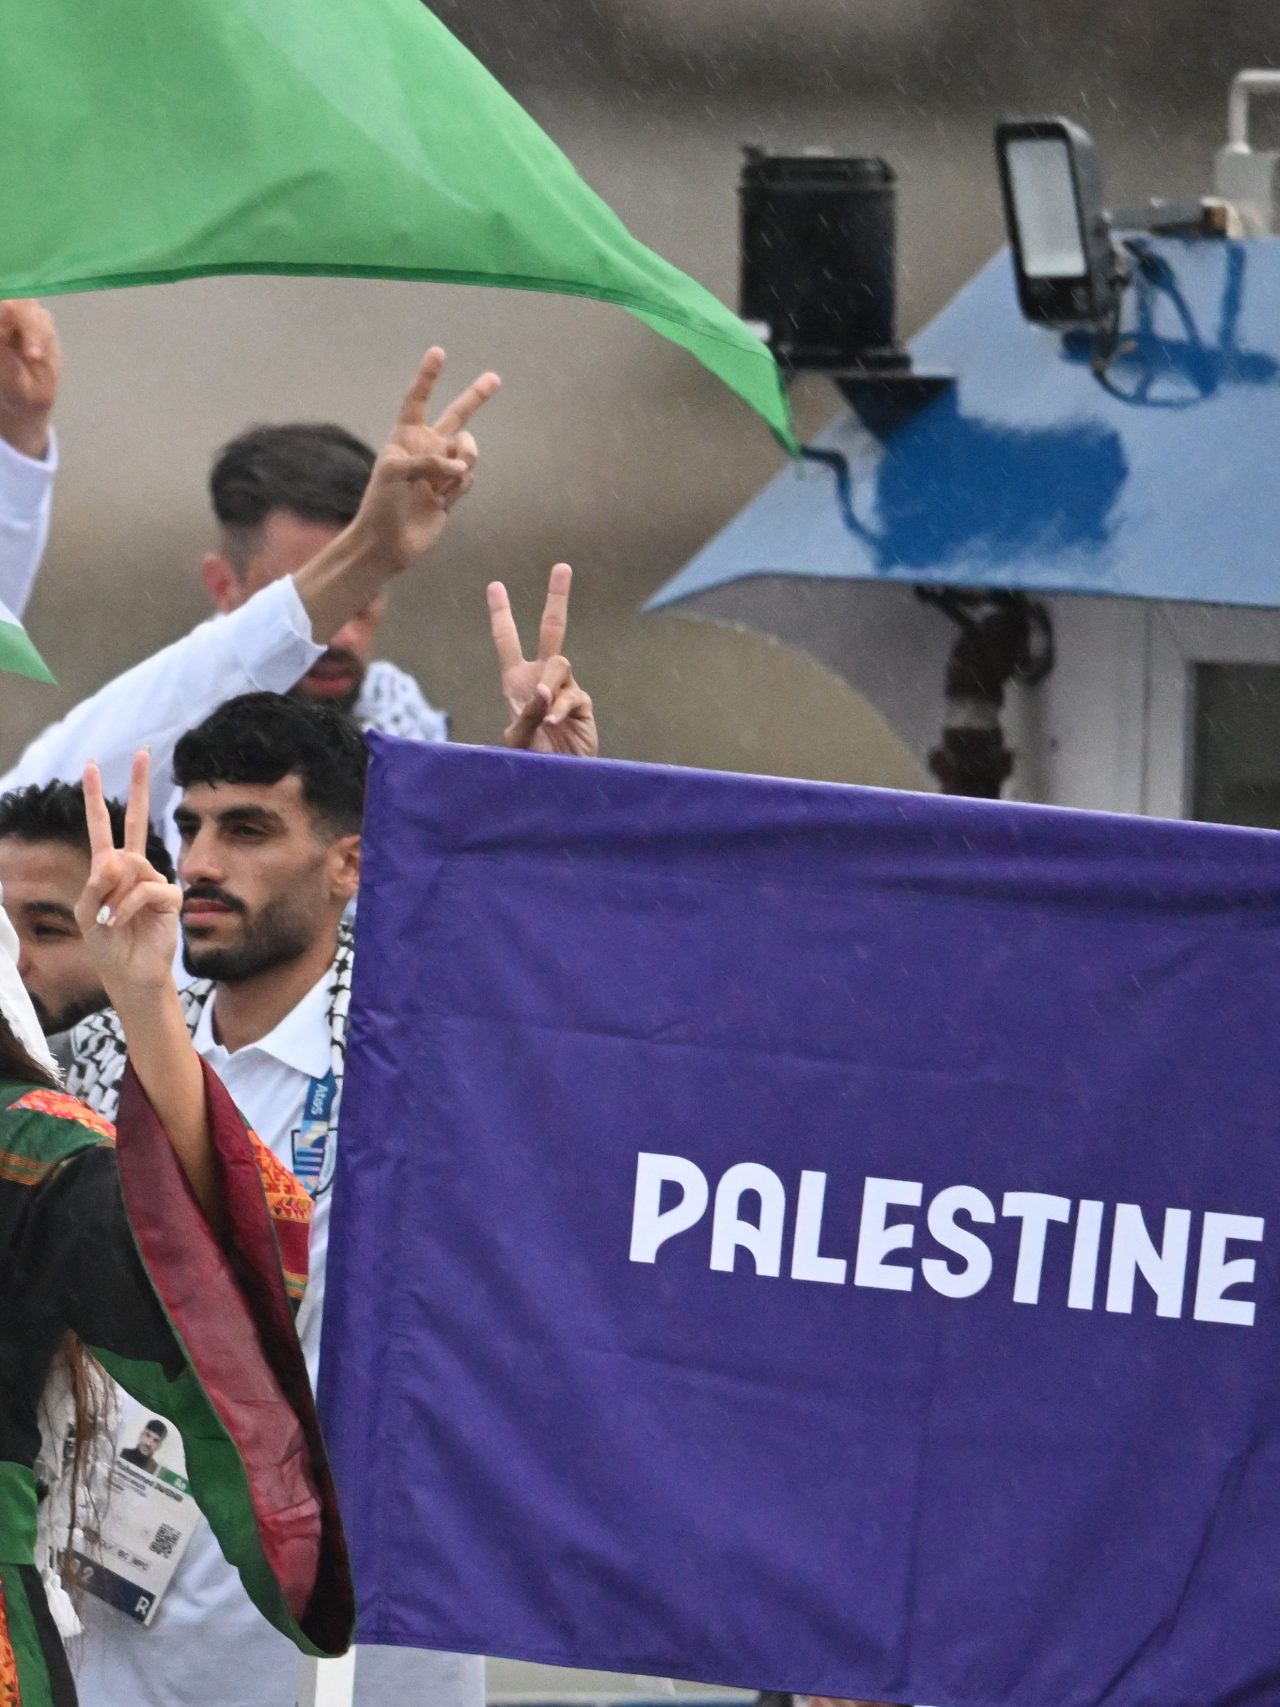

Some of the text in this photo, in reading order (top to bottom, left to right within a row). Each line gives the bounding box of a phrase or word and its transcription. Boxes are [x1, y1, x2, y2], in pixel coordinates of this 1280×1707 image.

[311, 1083, 329, 1116] Atos
[629, 1151, 1265, 1327] PALESTINE
[134, 1596, 150, 1616] R
